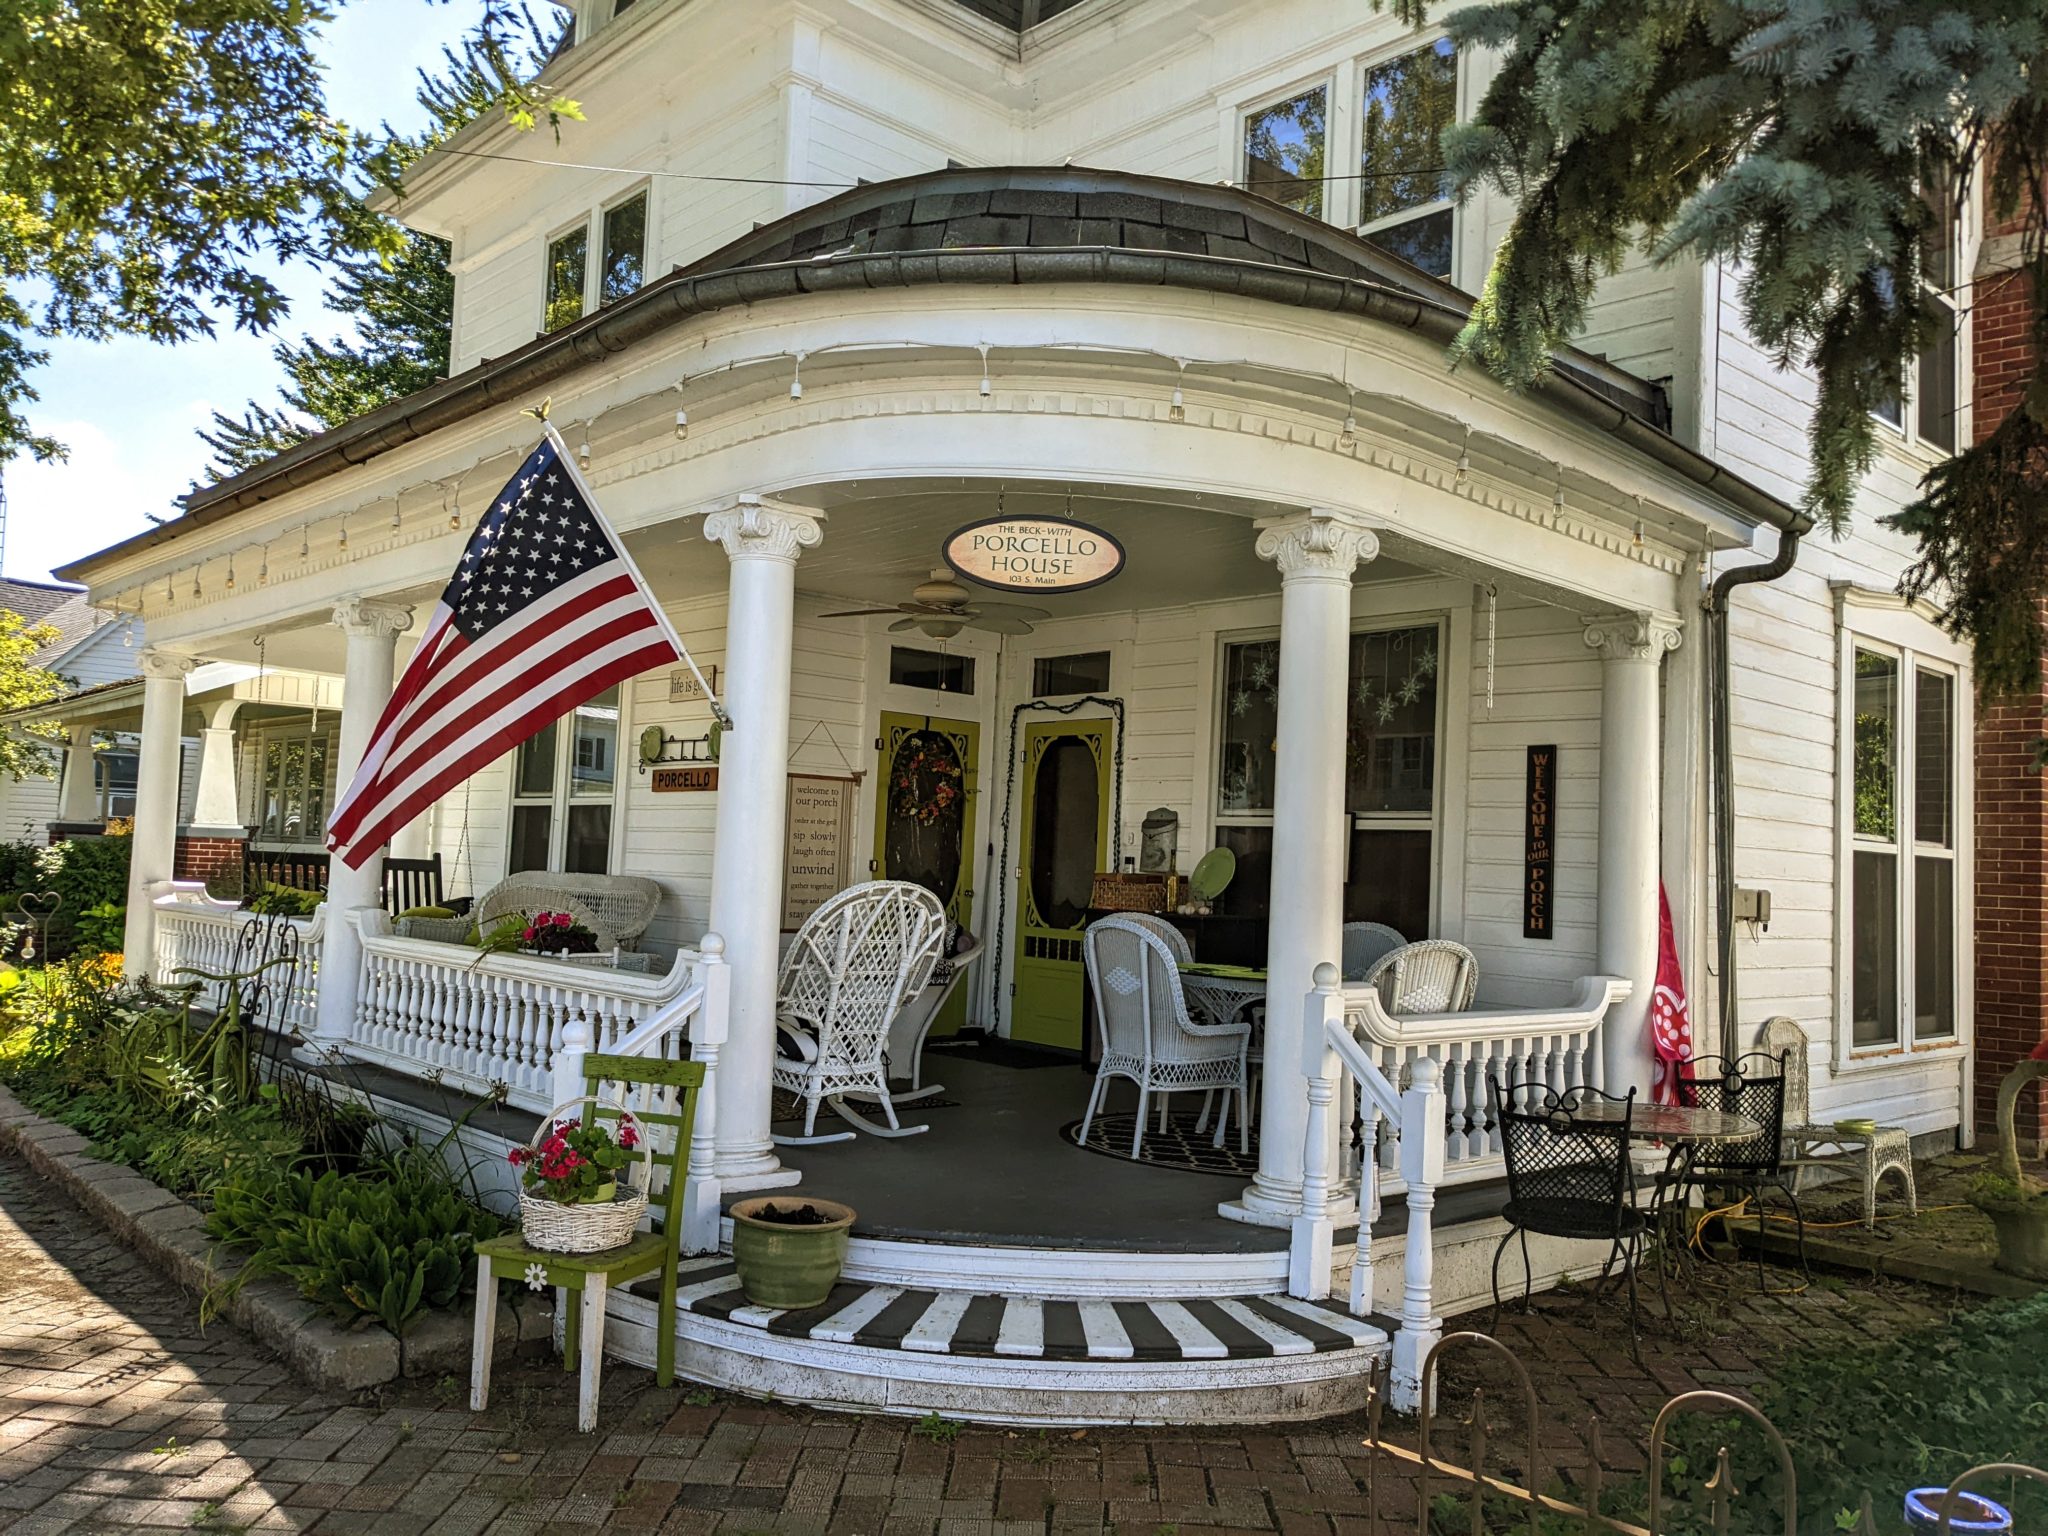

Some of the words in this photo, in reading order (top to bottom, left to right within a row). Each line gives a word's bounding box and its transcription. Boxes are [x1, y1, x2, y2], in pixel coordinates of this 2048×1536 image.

[999, 526, 1015, 534] THE
[1019, 526, 1073, 536] BECK-WITH
[972, 534, 1097, 556] PORCELLO
[991, 555, 1075, 575] HOUSE
[1009, 575, 1022, 584] 103
[1035, 576, 1056, 585] Main
[671, 676, 684, 694] life
[685, 676, 692, 693] is
[658, 770, 711, 788] PORCELLO
[797, 786, 830, 796] welcome
[831, 787, 839, 796] to
[1531, 753, 1550, 838] WELCOME
[795, 798, 811, 806] our
[812, 796, 838, 808] porch
[793, 831, 806, 842] sip
[810, 830, 837, 844] slowly
[792, 844, 813, 858] laugh
[815, 846, 836, 857] often
[1532, 840, 1546, 850] TO
[1527, 848, 1550, 861] OUR
[792, 862, 835, 876] unwind
[791, 882, 809, 890] gather
[810, 882, 834, 891] together
[791, 897, 809, 905] lounge
[1530, 868, 1545, 930] PORCH
[788, 910, 805, 921] stay
